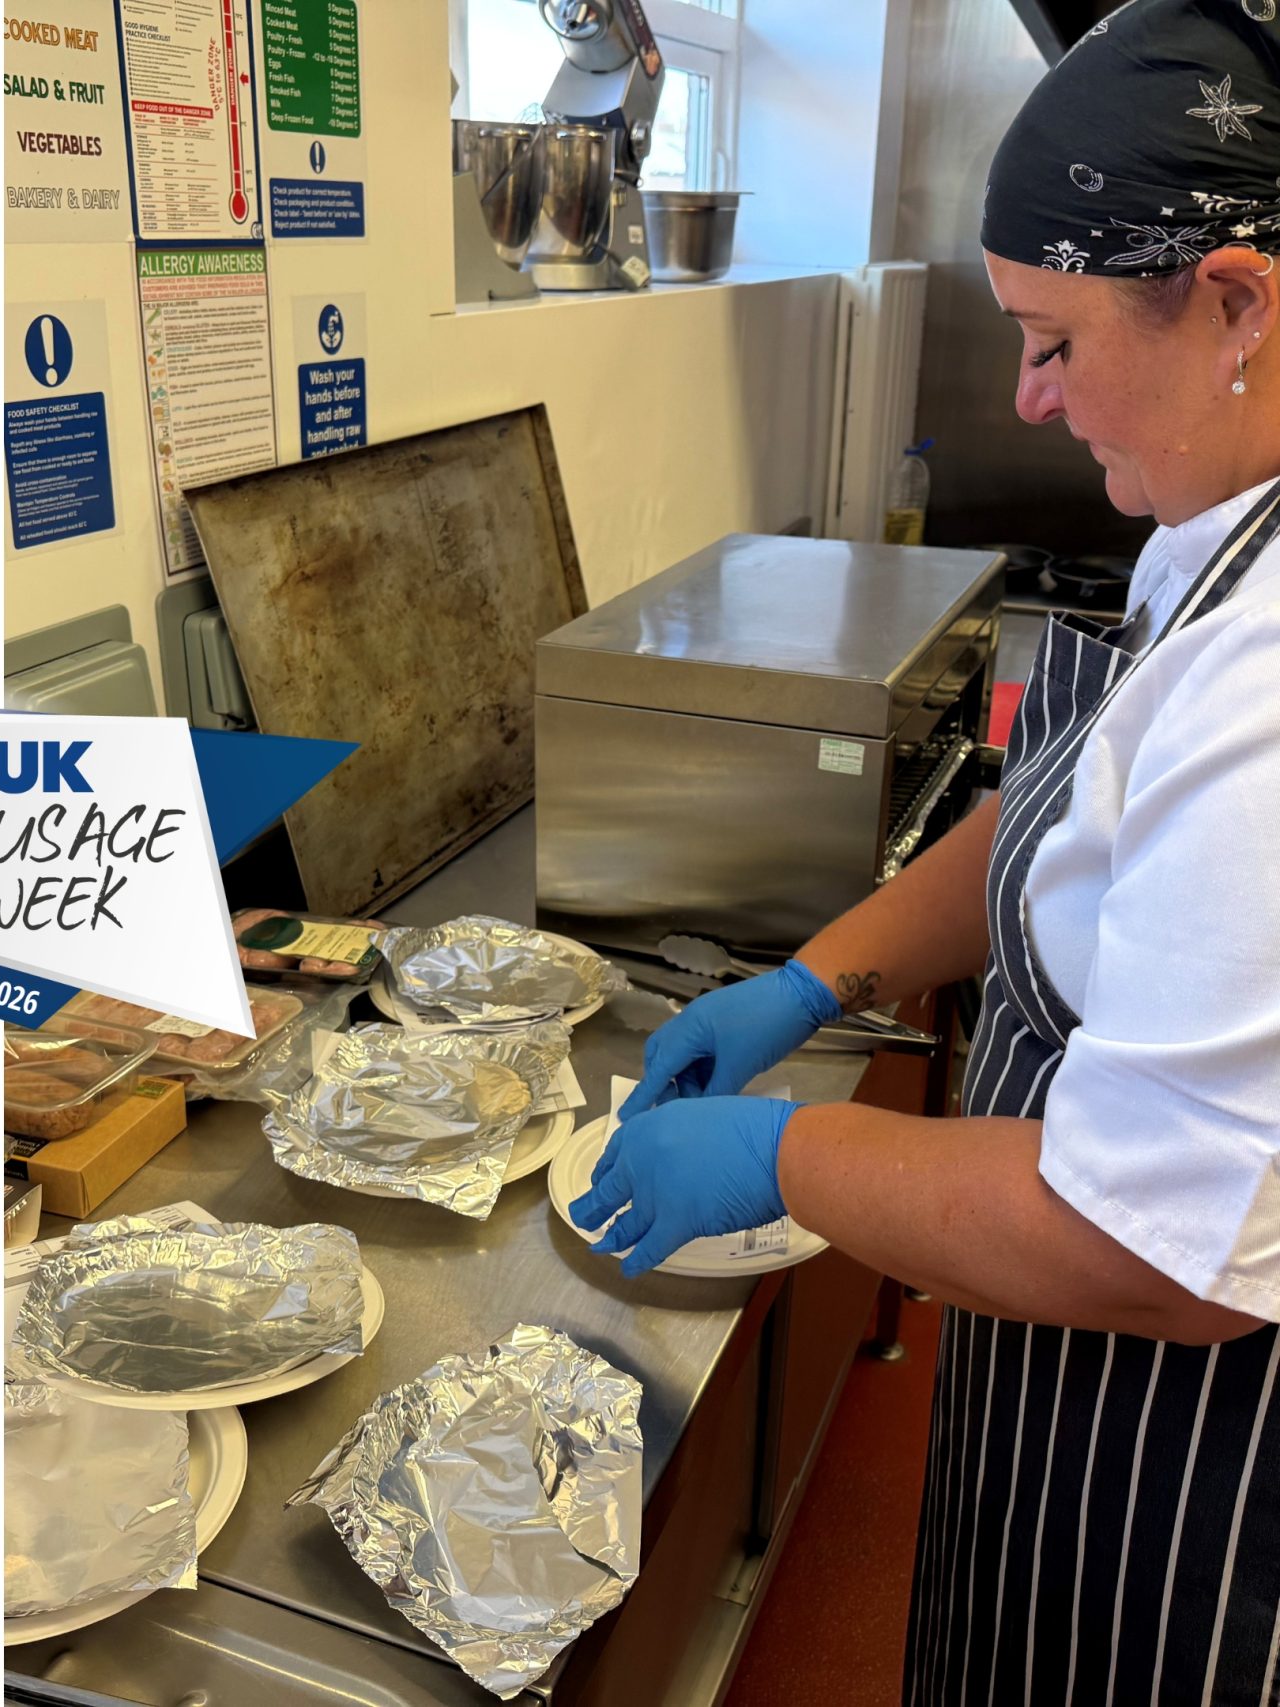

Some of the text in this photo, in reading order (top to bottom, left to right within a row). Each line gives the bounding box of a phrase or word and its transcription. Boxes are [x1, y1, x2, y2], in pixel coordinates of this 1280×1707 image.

[4, 17, 98, 52] COOKED MEAT
[125, 22, 159, 32] GOOD HYGIENE
[126, 30, 171, 42] PRACTICE CHECKLIST
[4, 74, 105, 104] SALAD & FRUIT
[17, 131, 102, 156] VEGETABLES
[7, 187, 120, 210] BAKERY & DAIRY
[140, 253, 265, 276] ALLERGY AWARENESS
[309, 368, 355, 386] Wash your
[305, 386, 360, 406] hands before
[8, 402, 80, 418] FOOD SAFETY CHECKLIST
[315, 406, 353, 424] and after
[307, 425, 361, 444] handling raw
